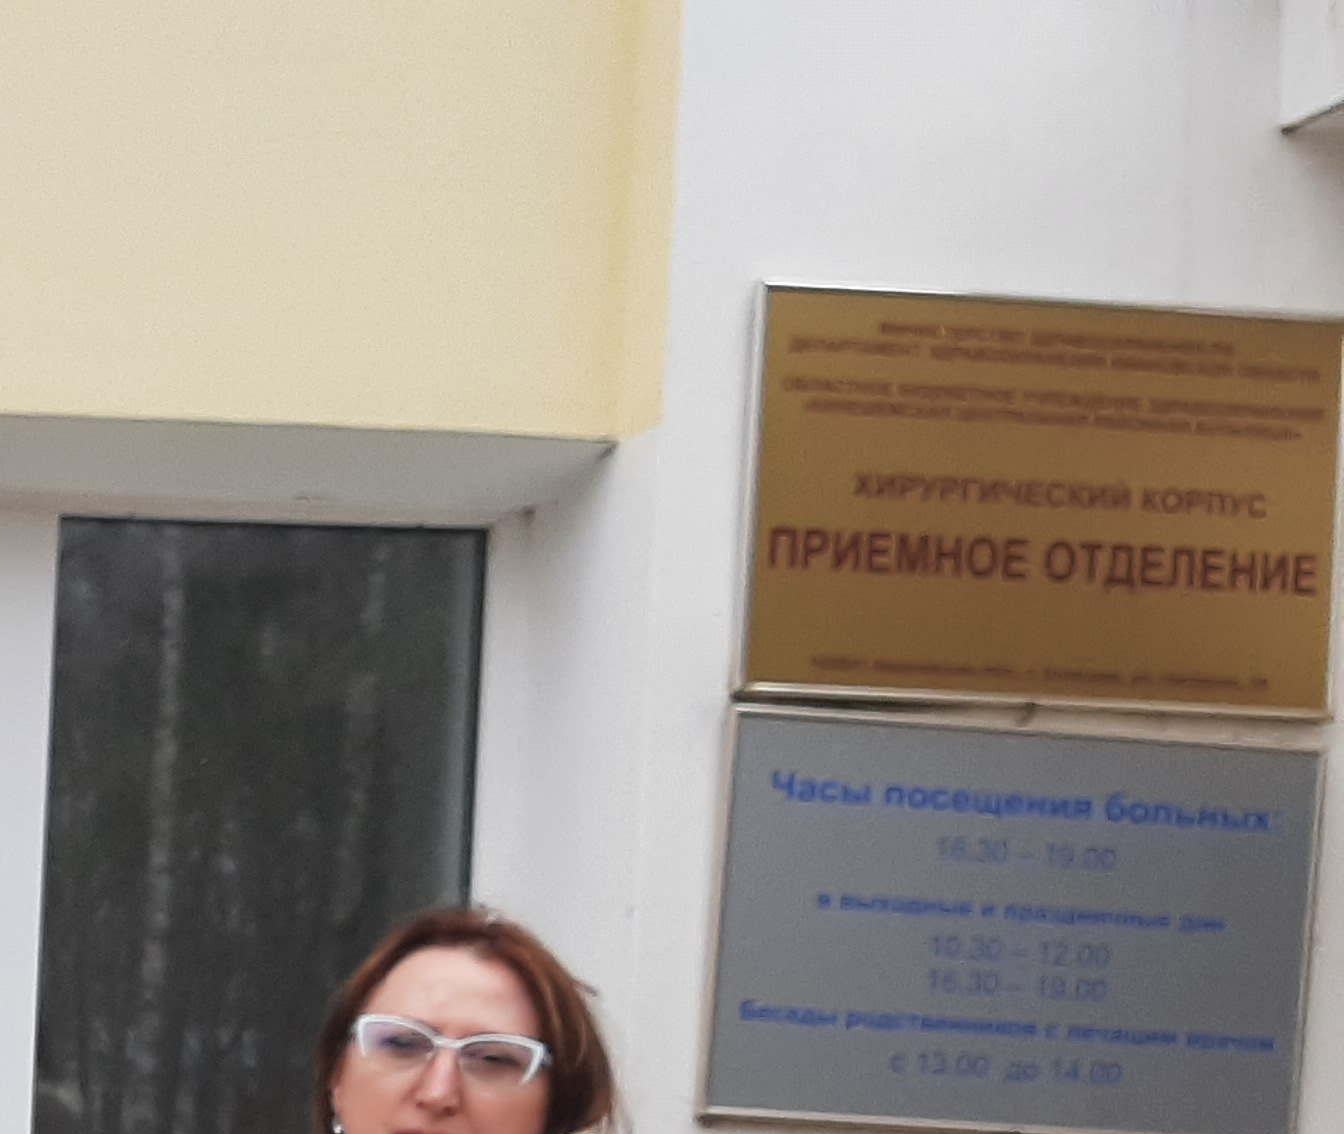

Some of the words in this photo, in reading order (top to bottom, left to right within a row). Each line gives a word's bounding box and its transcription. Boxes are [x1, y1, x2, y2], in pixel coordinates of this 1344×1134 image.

[853, 470, 1132, 512] ХИРУРГИЧЕСКИЙ
[1143, 485, 1269, 519] КОРПУС
[768, 525, 1029, 582] ПРИЕМНОЕ
[1044, 540, 1318, 597] ОТДЕЛЕНИЕ
[772, 770, 872, 806] Часы
[884, 785, 1092, 821] посещения
